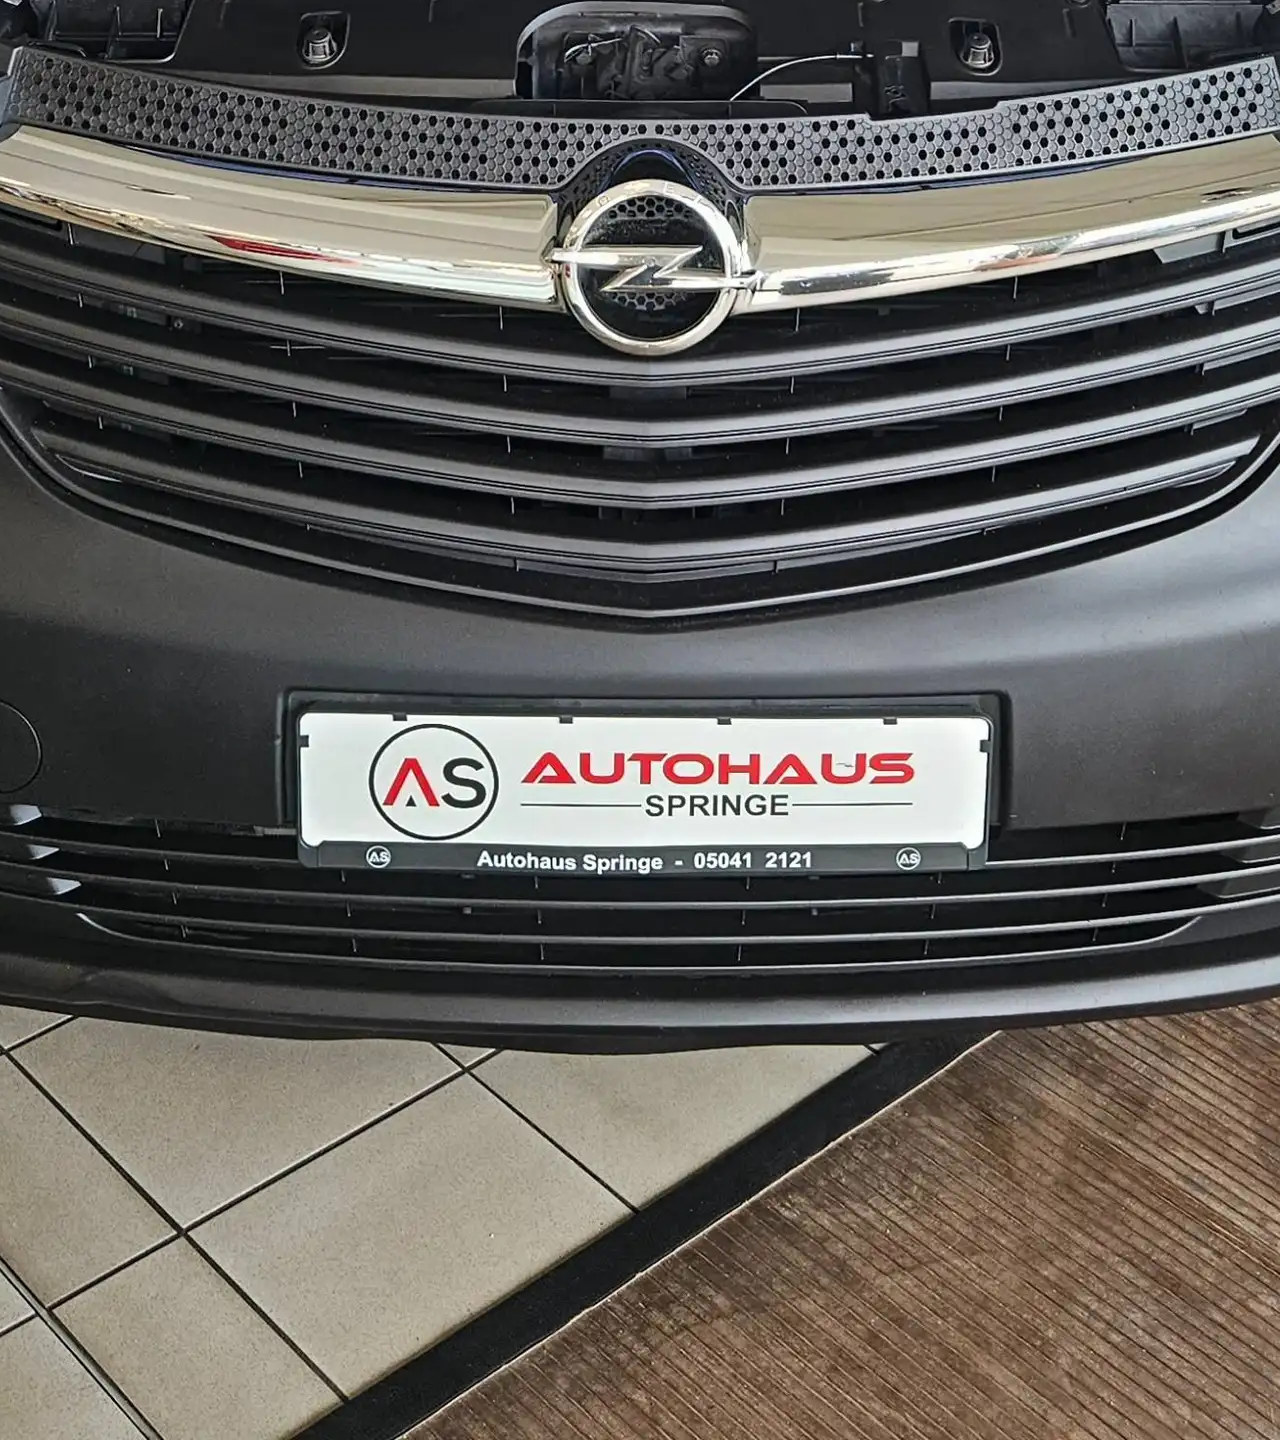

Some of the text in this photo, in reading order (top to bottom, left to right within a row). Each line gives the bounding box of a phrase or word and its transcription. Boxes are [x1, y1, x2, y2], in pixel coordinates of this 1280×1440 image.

[521, 751, 915, 785] AUTOHAUS
[382, 757, 487, 809] AS
[645, 794, 790, 817] SPRINGE
[477, 850, 577, 871] Autohaus
[582, 854, 663, 875] Springe
[694, 852, 753, 870] 05041
[765, 851, 812, 869] 2121
